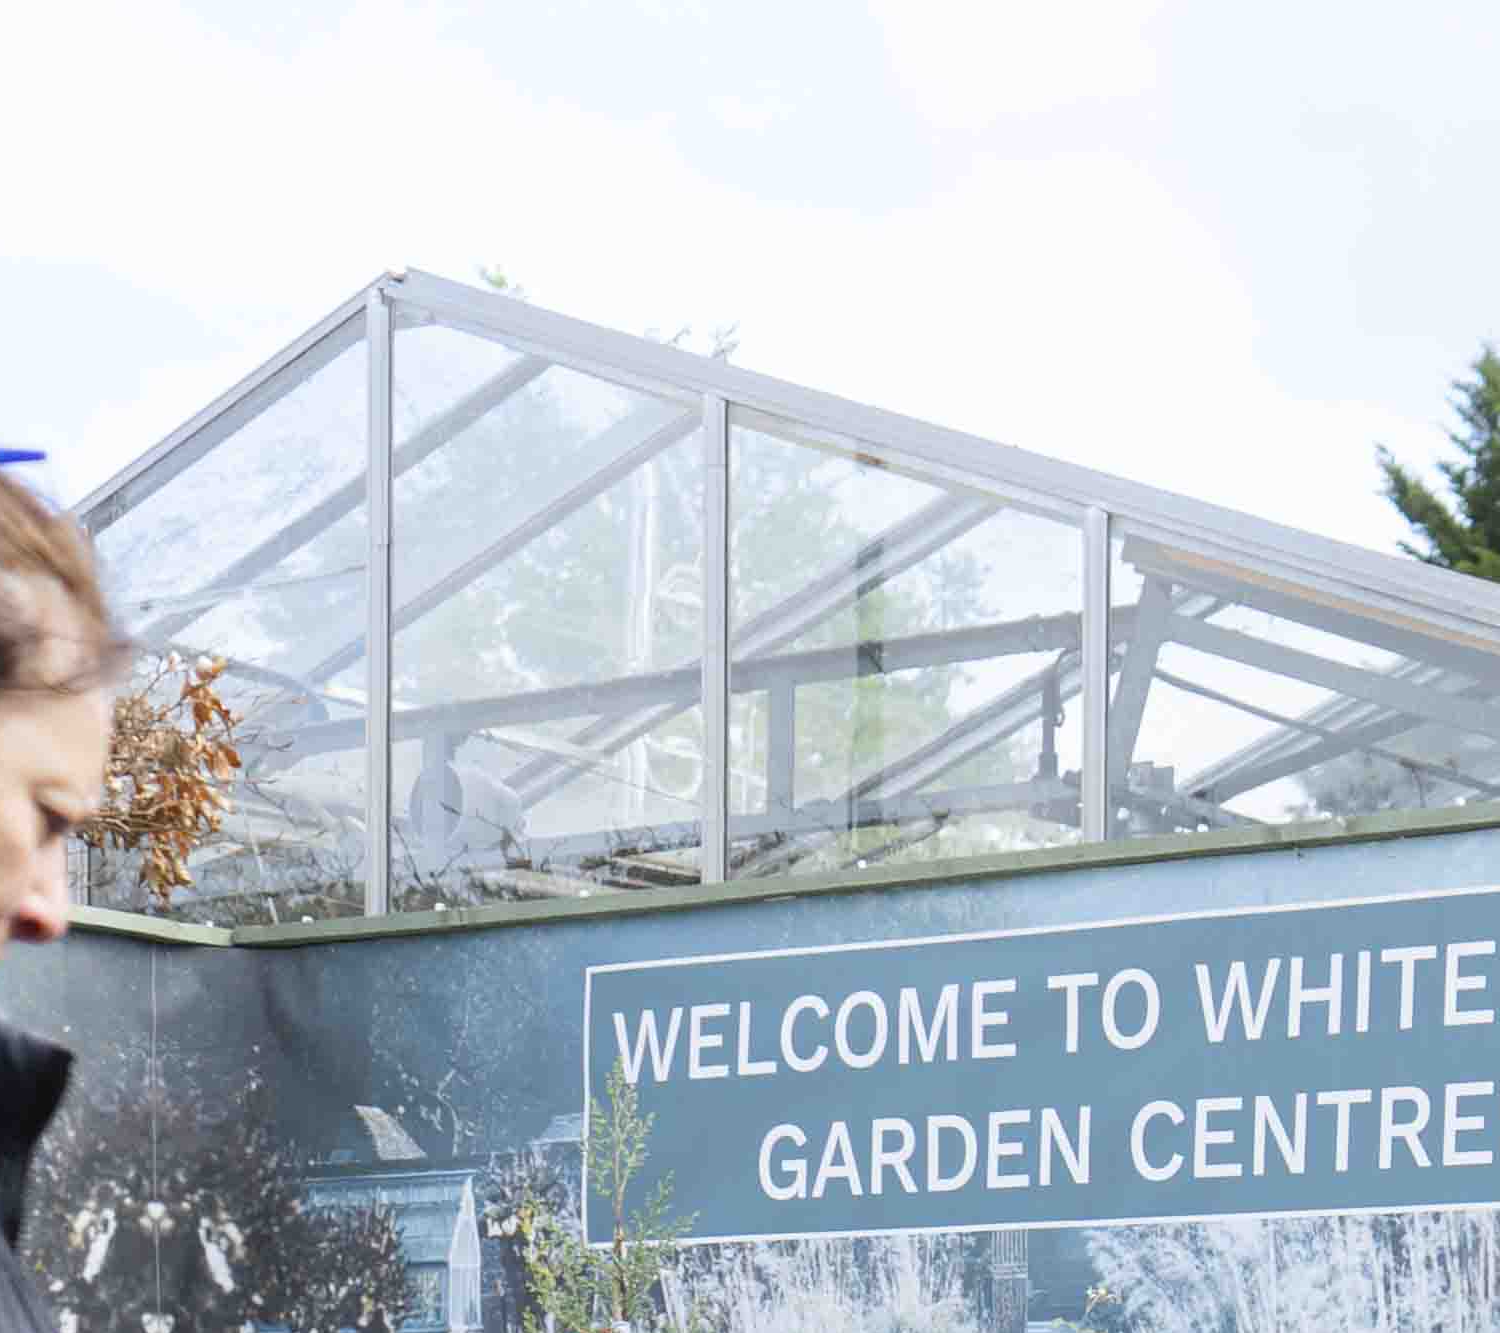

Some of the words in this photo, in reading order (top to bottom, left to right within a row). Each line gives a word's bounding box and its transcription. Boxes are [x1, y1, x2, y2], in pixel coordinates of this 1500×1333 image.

[613, 978, 1018, 1083] WELCOME
[1047, 966, 1162, 1054] TO
[757, 1104, 1093, 1201] GARDEN
